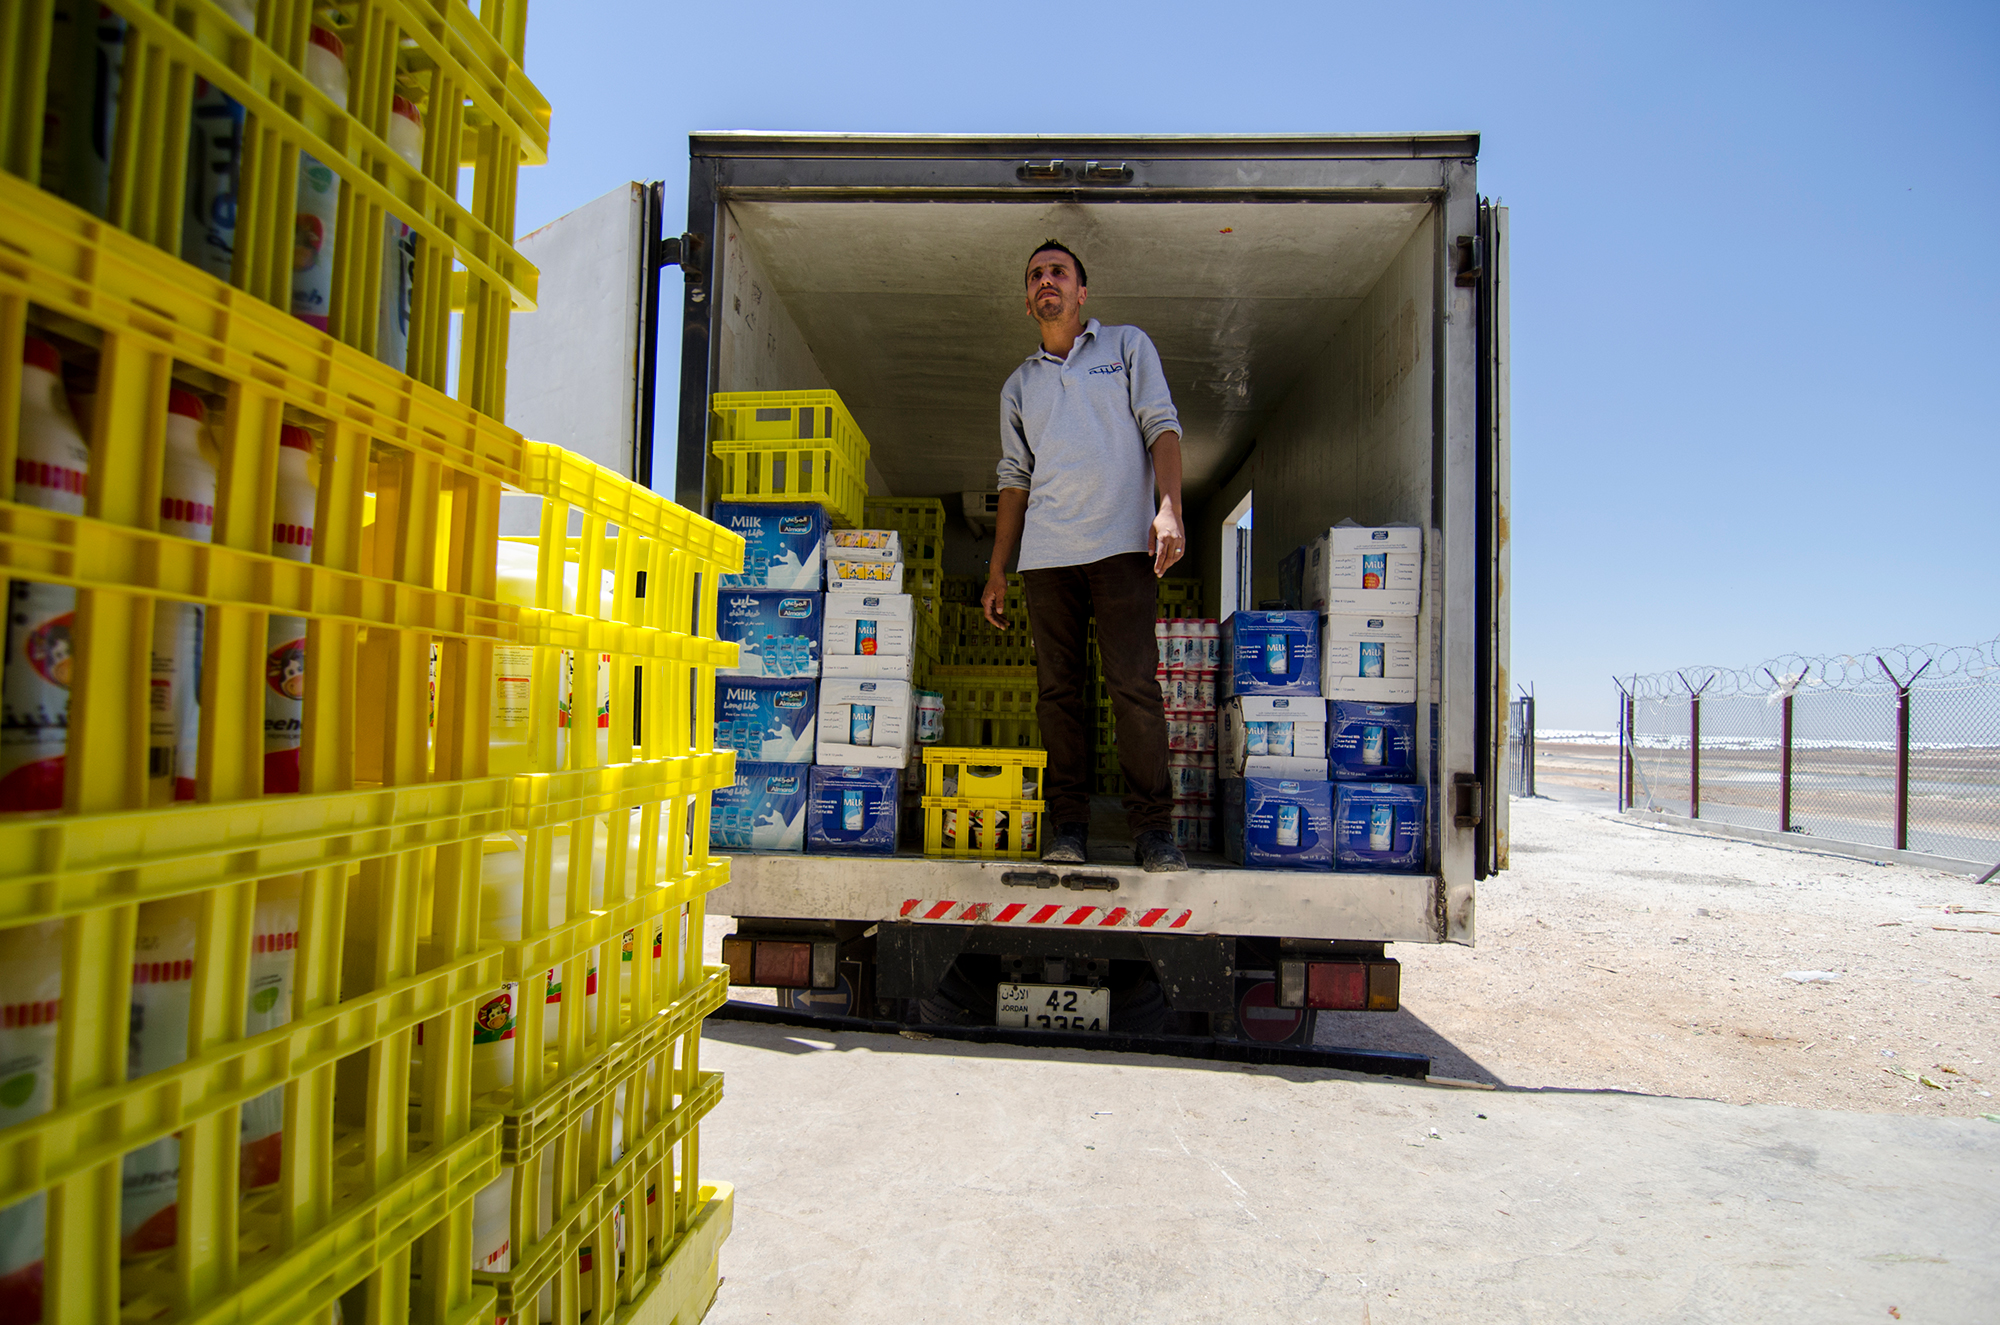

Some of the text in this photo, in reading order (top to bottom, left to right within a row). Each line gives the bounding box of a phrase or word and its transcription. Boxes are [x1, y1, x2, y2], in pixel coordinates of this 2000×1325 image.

[731, 516, 761, 528] Milk
[747, 528, 765, 538] Life
[730, 594, 759, 608] حليب
[1266, 644, 1286, 652] Milk
[727, 688, 756, 701] Milk
[724, 701, 760, 712] Long Life
[852, 713, 873, 721] Milk
[844, 798, 863, 806] Milk
[1046, 990, 1078, 1012] 42
